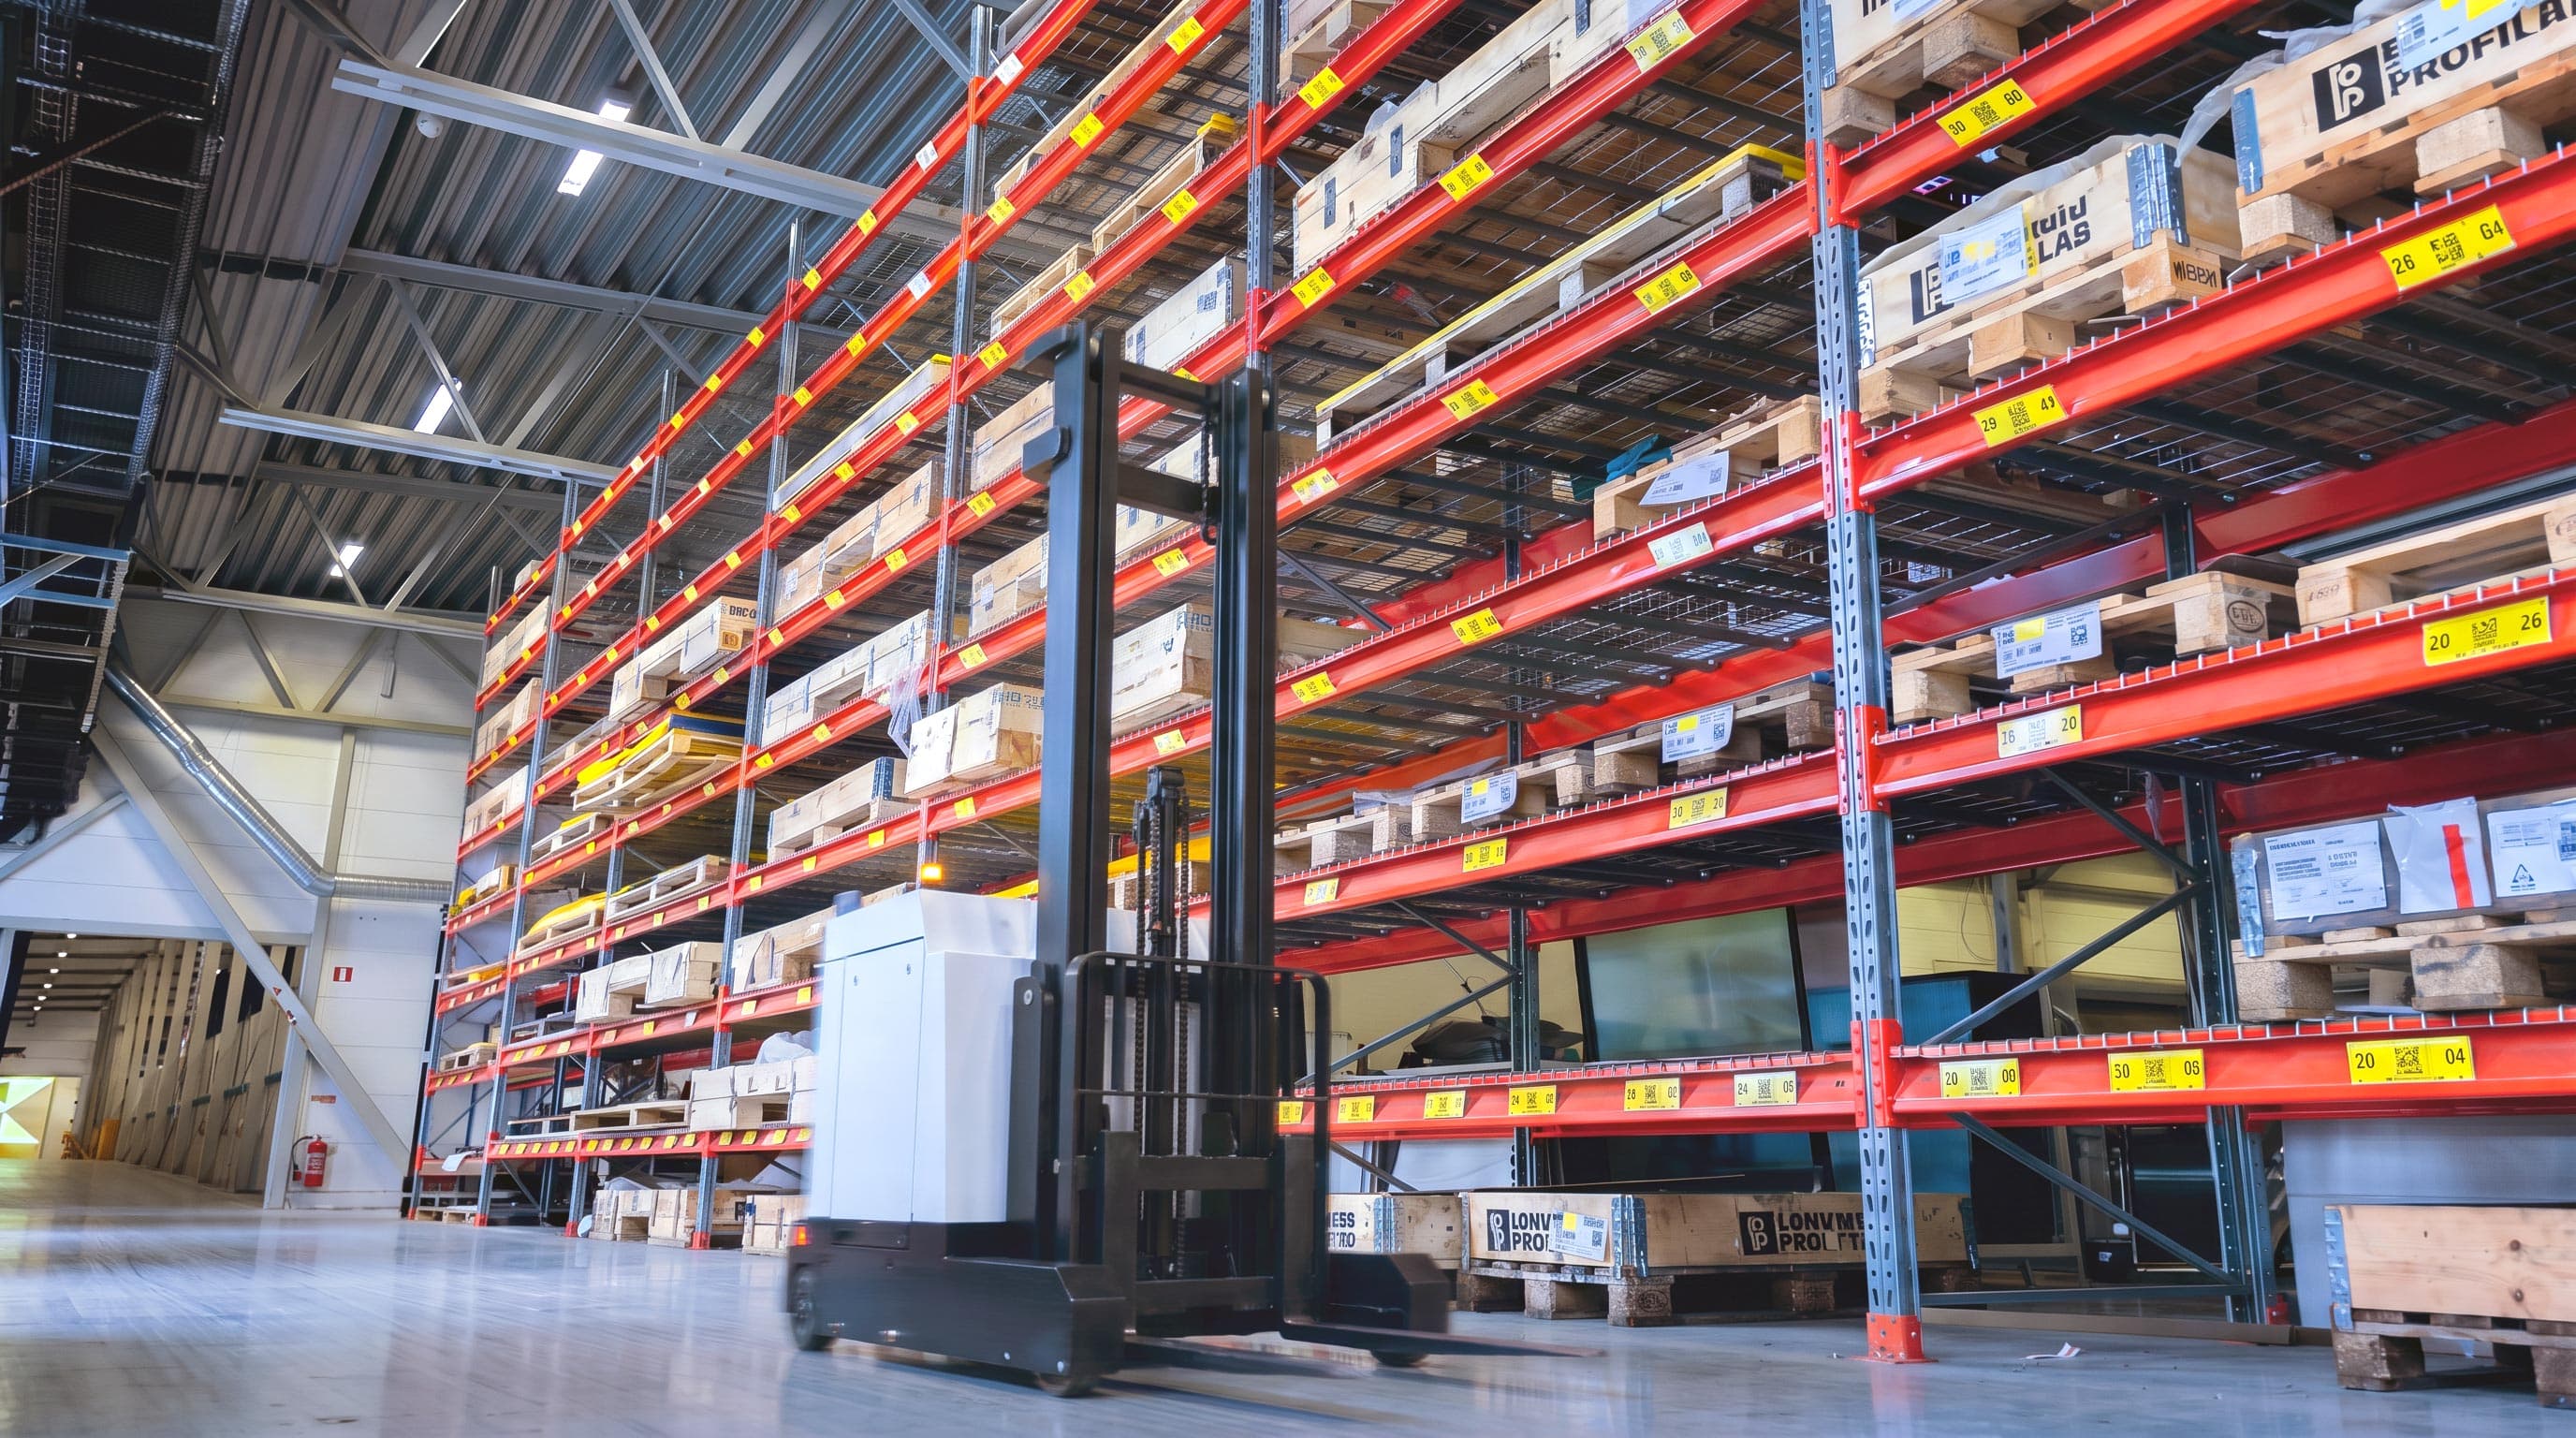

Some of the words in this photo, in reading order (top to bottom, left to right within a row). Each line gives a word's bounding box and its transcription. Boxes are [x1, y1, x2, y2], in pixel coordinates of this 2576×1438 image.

[2388, 0, 2576, 97] PROFILA
[1948, 120, 1967, 136] 30
[2392, 254, 2416, 275] 26
[1981, 417, 1998, 433] 29
[2429, 633, 2451, 651] 20
[2520, 612, 2542, 631] 26
[2061, 715, 2077, 732] 20
[1673, 806, 1683, 818] 30
[1713, 797, 1724, 810] 20
[2355, 1052, 2376, 1069] 20
[2445, 1048, 2466, 1064] 04
[1737, 1082, 1748, 1095] 24
[1945, 1072, 1958, 1086] 20
[1511, 1212, 1551, 1231] LONV
